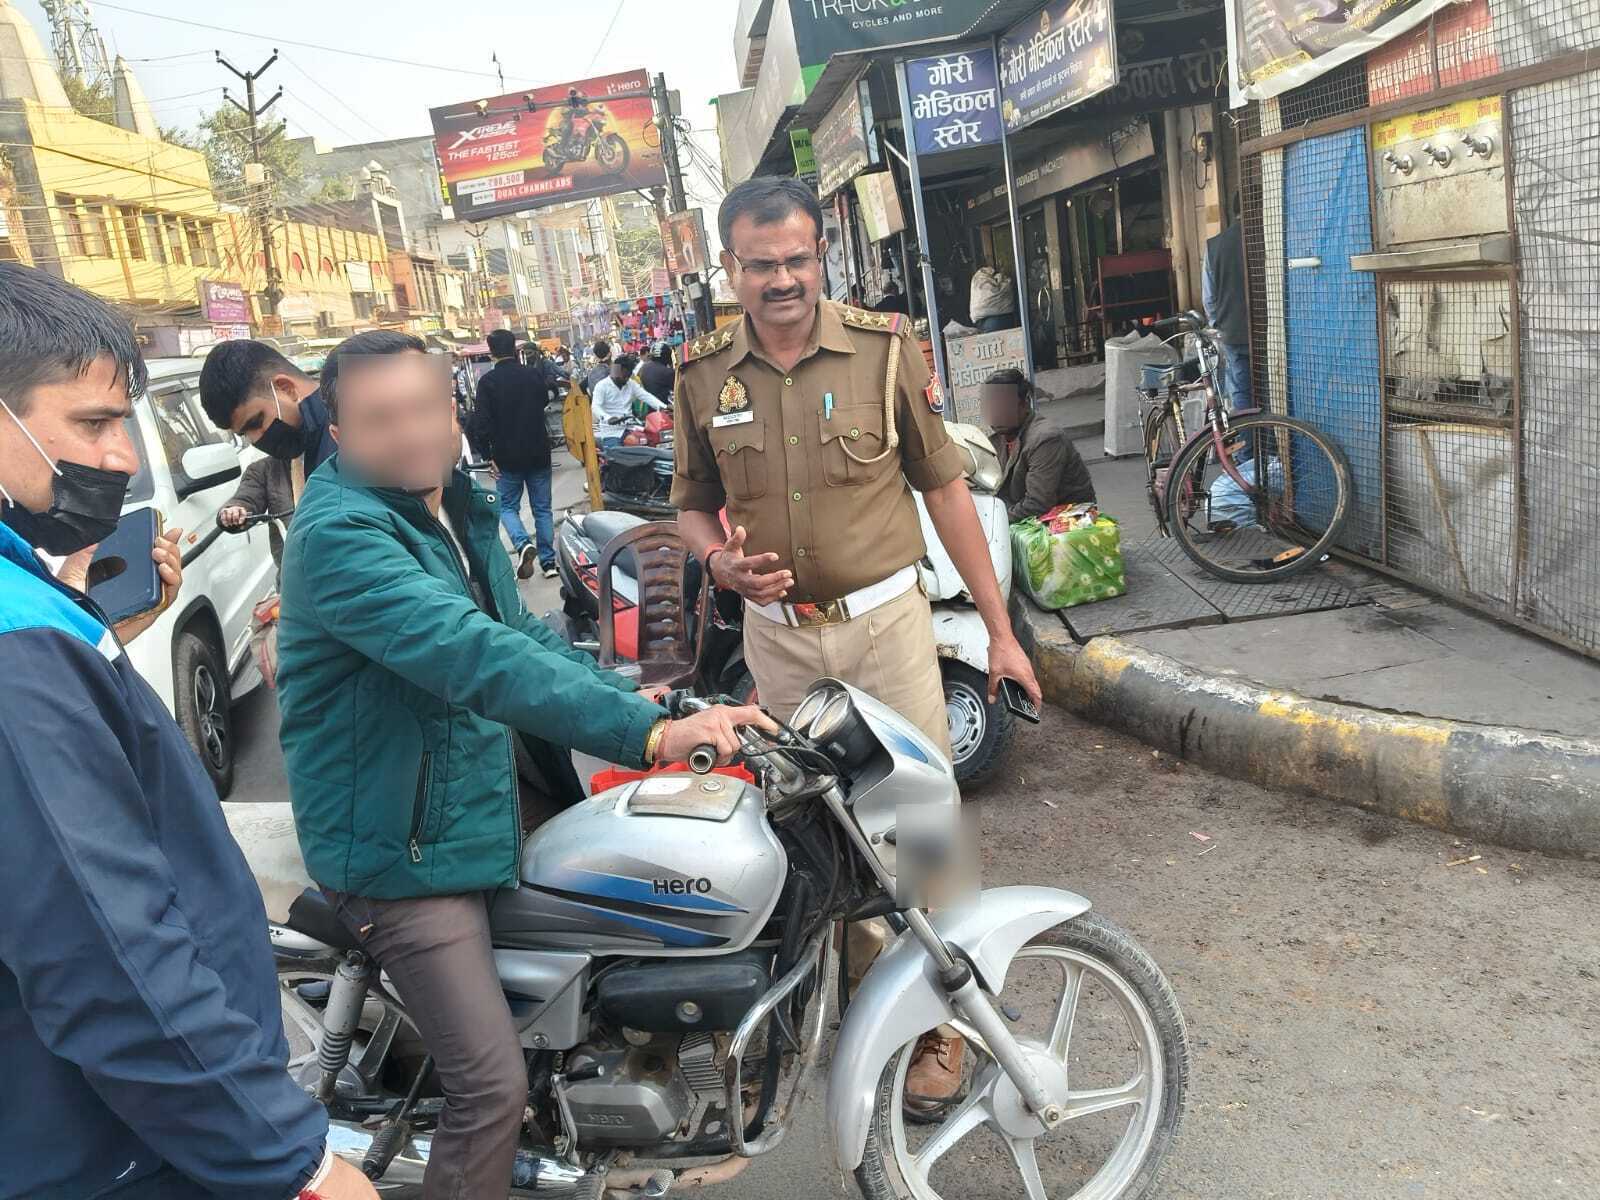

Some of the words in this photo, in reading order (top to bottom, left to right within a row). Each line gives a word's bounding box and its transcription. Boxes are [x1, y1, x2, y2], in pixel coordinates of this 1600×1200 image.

[852, 17, 890, 29] CYCLES
[892, 12, 912, 24] AND
[915, 6, 944, 18] MORE
[617, 80, 641, 91] Hero
[913, 88, 996, 119] मेडिकल
[933, 119, 982, 148] स्टोर
[448, 149, 470, 161] THE
[470, 140, 521, 157] FASTEST
[496, 187, 518, 200] DUAL
[518, 179, 556, 194] CHANNEL
